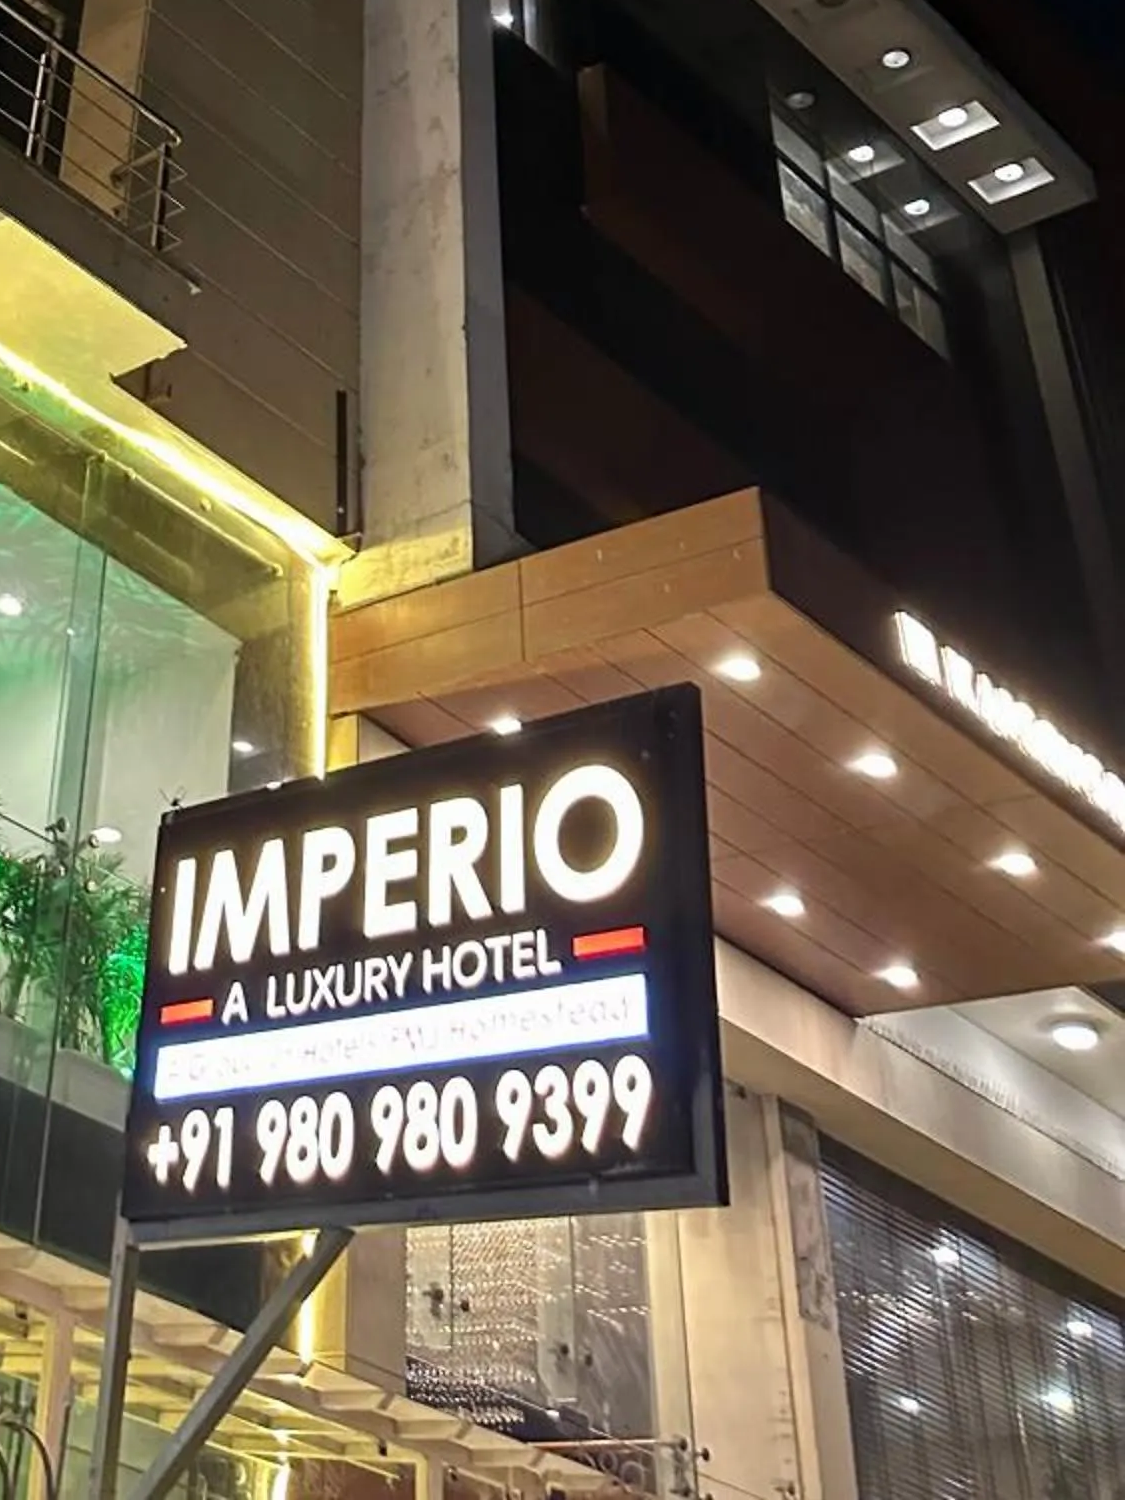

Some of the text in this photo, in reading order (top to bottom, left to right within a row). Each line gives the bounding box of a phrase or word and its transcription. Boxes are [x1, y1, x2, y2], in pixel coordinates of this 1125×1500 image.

[168, 764, 644, 975] IMPERIO
[220, 929, 563, 1026] A LUXURY HOTEL
[146, 1054, 653, 1194] +91 980 980 9399
